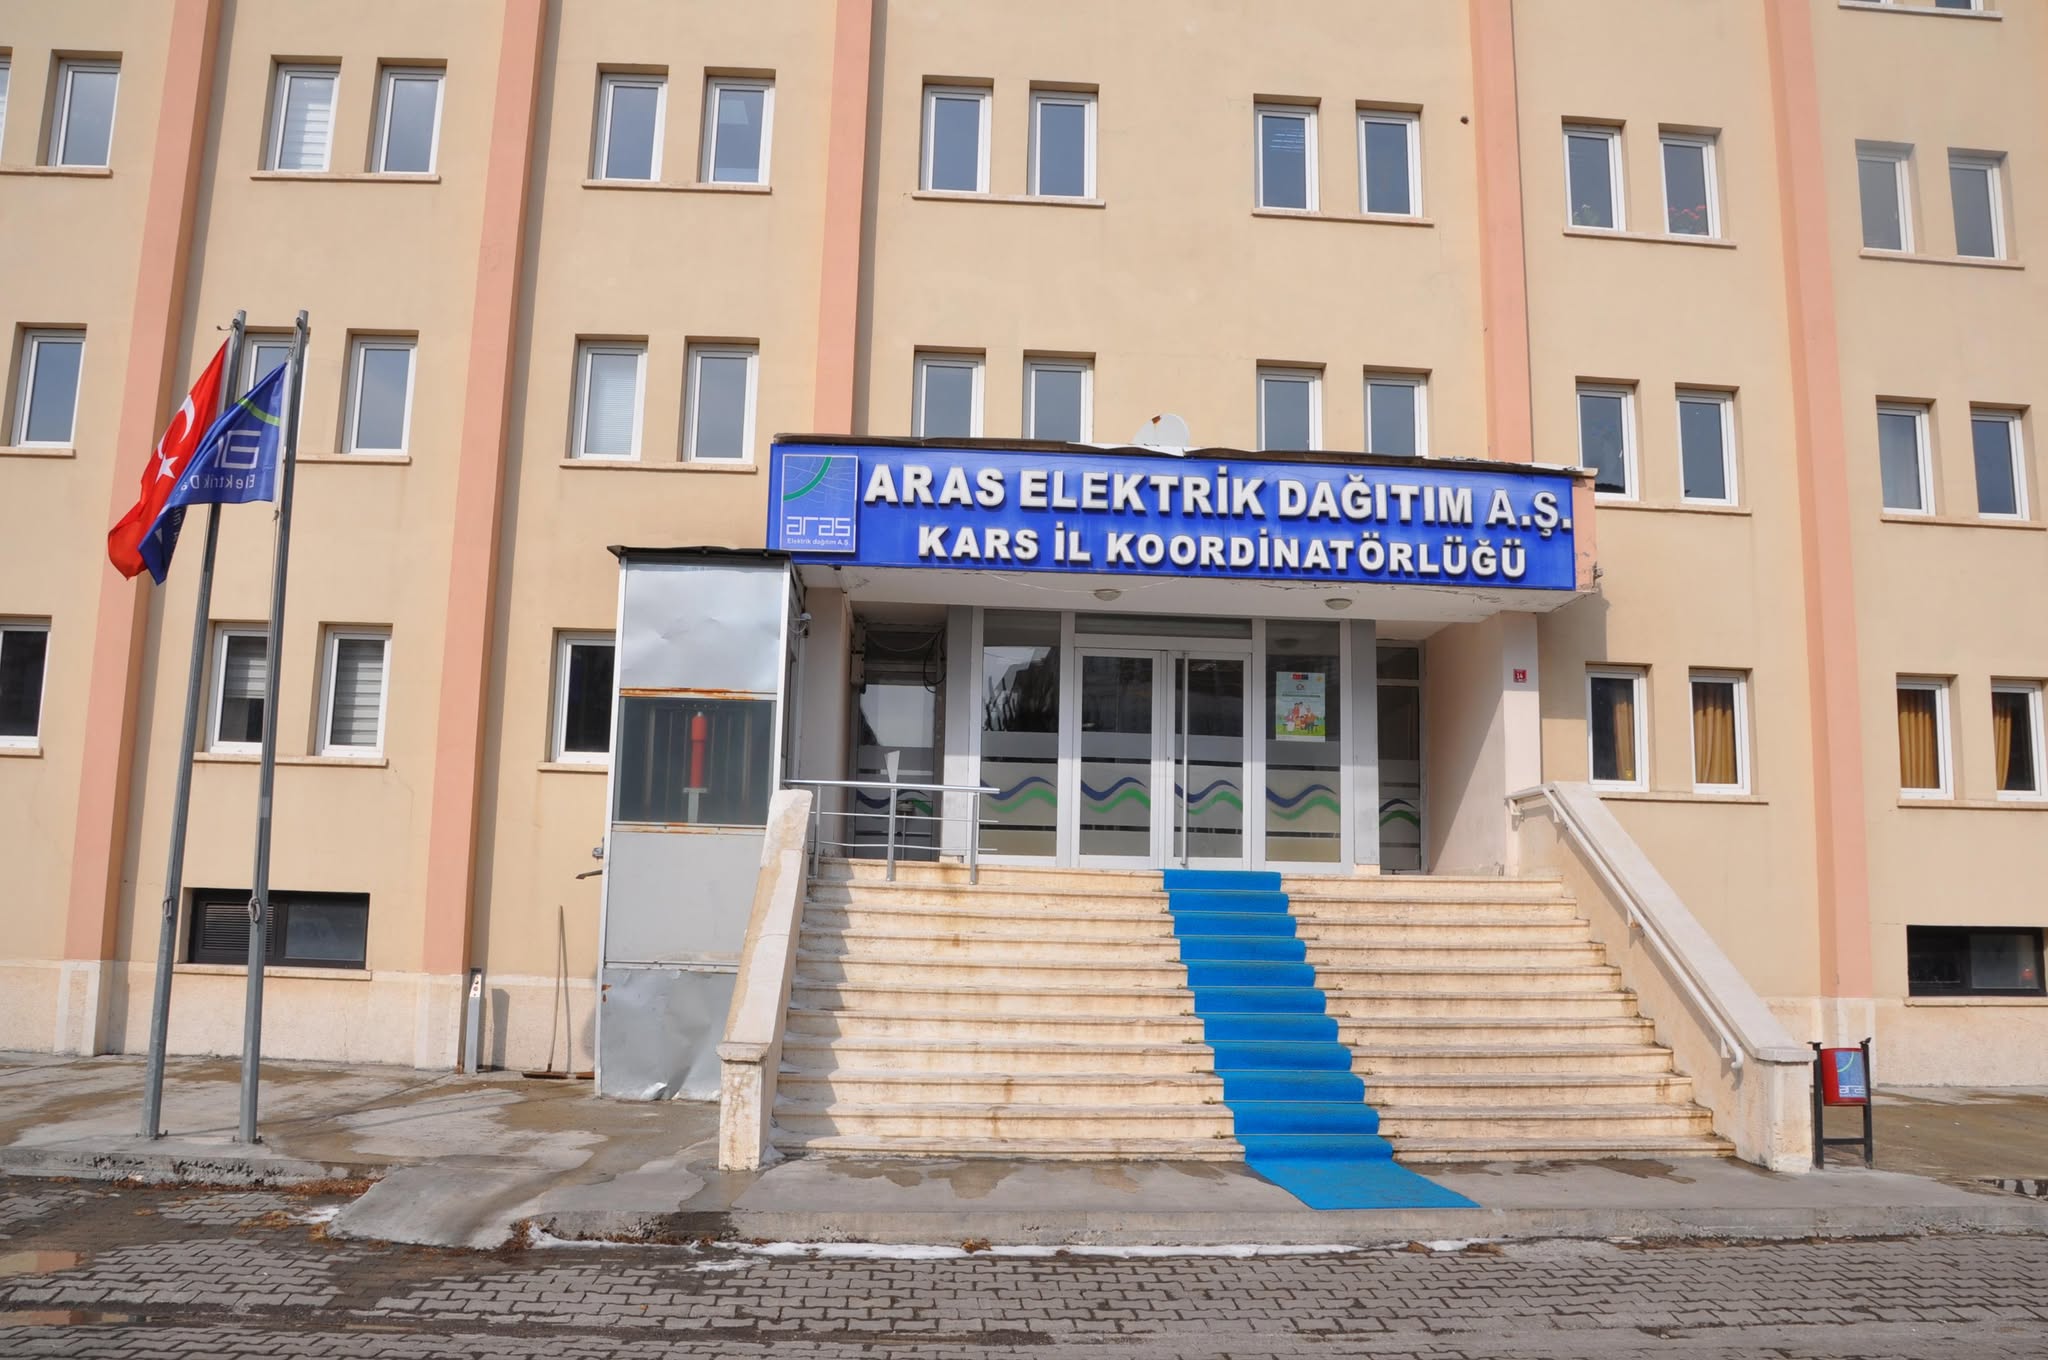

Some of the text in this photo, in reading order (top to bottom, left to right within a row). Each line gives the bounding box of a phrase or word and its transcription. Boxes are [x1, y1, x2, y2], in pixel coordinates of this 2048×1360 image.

[863, 463, 1573, 537] ARAS ELEKTRİK DAĞITIM A.Ş.
[785, 515, 851, 537] aras
[786, 537, 812, 545] Elektrik
[917, 521, 1527, 578] KARS İL KOORDİNATÖRLÜĞÜ
